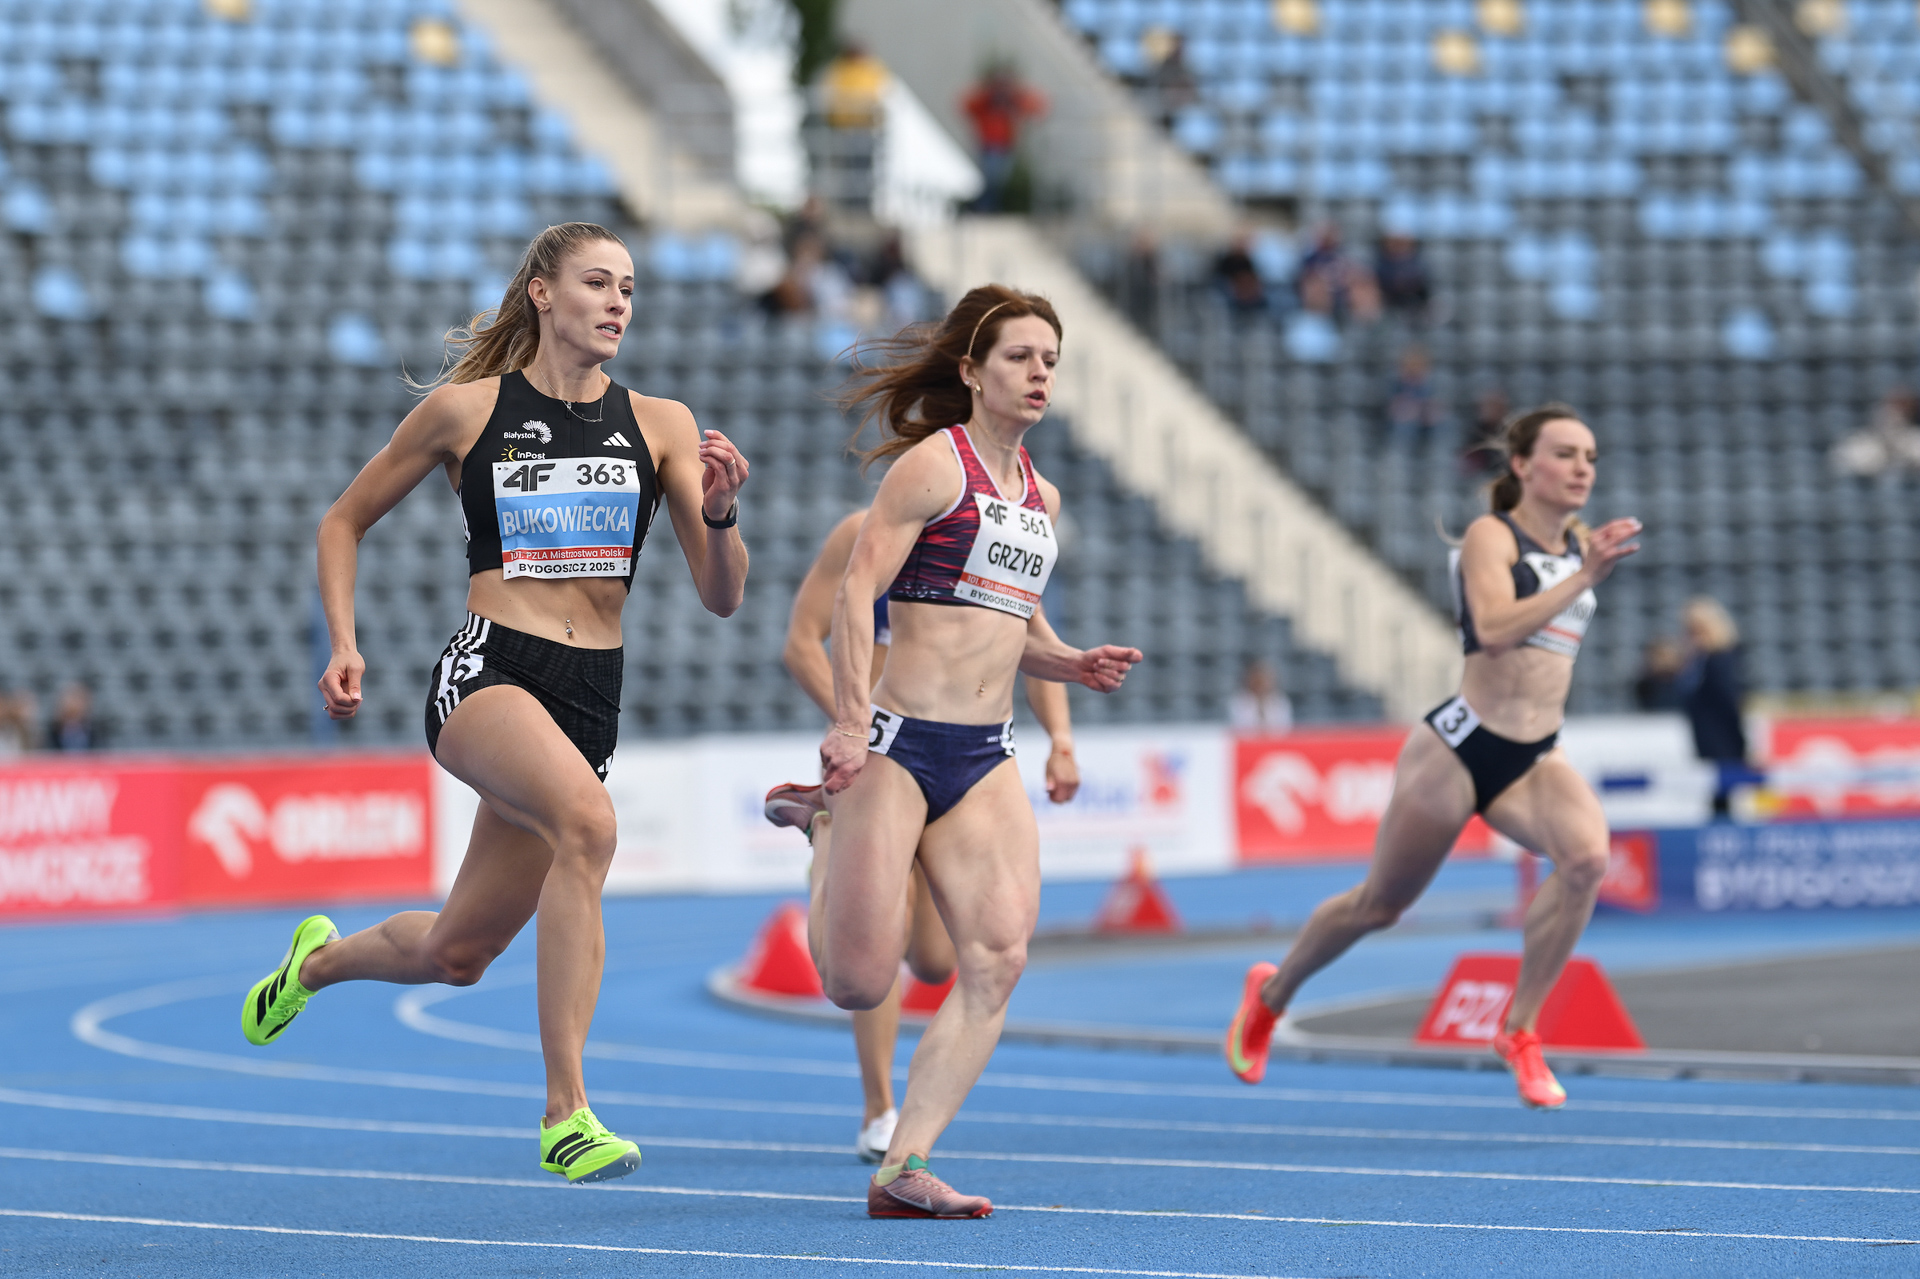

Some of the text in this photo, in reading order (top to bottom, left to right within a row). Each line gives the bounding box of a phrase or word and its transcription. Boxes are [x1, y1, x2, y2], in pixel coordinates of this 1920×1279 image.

[503, 431, 537, 440] Białystok
[517, 451, 546, 460] InPost
[503, 463, 627, 492] 4F 363
[502, 505, 630, 537] BUKOWIECKA
[985, 501, 1049, 539] 4F 561
[518, 562, 616, 574] BYDGOSZCZ 2025
[526, 550, 548, 560] PZLA
[550, 549, 598, 560] Mistrzostwa
[600, 548, 625, 558] Polski
[987, 541, 1044, 578] GRZYB
[447, 653, 472, 687] 6
[868, 710, 891, 748] 5
[1442, 706, 1469, 735] 3
[272, 792, 422, 860] ORLEN
